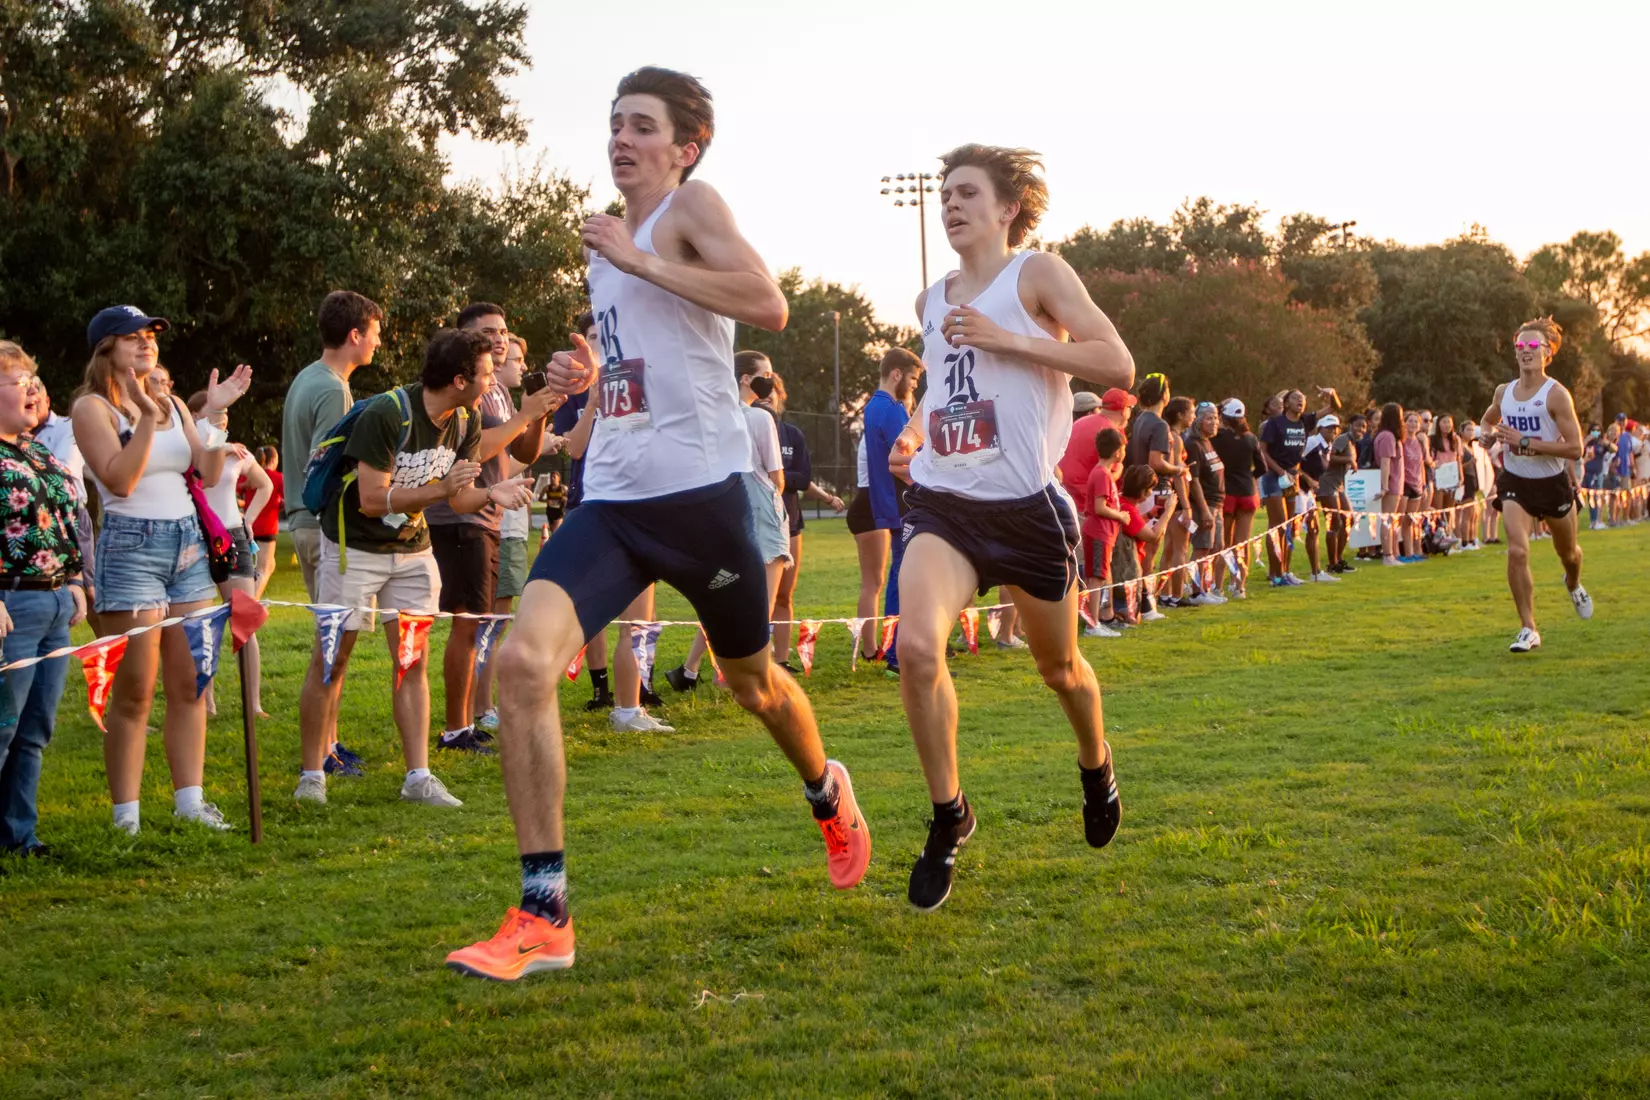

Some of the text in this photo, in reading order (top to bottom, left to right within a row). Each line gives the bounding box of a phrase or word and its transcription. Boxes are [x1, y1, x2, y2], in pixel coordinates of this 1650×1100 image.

[597, 305, 624, 363] R
[944, 349, 980, 407] R
[603, 379, 632, 414] 173
[941, 419, 982, 452] 174
[1506, 415, 1541, 432] HBU
[708, 573, 740, 590] adidas
